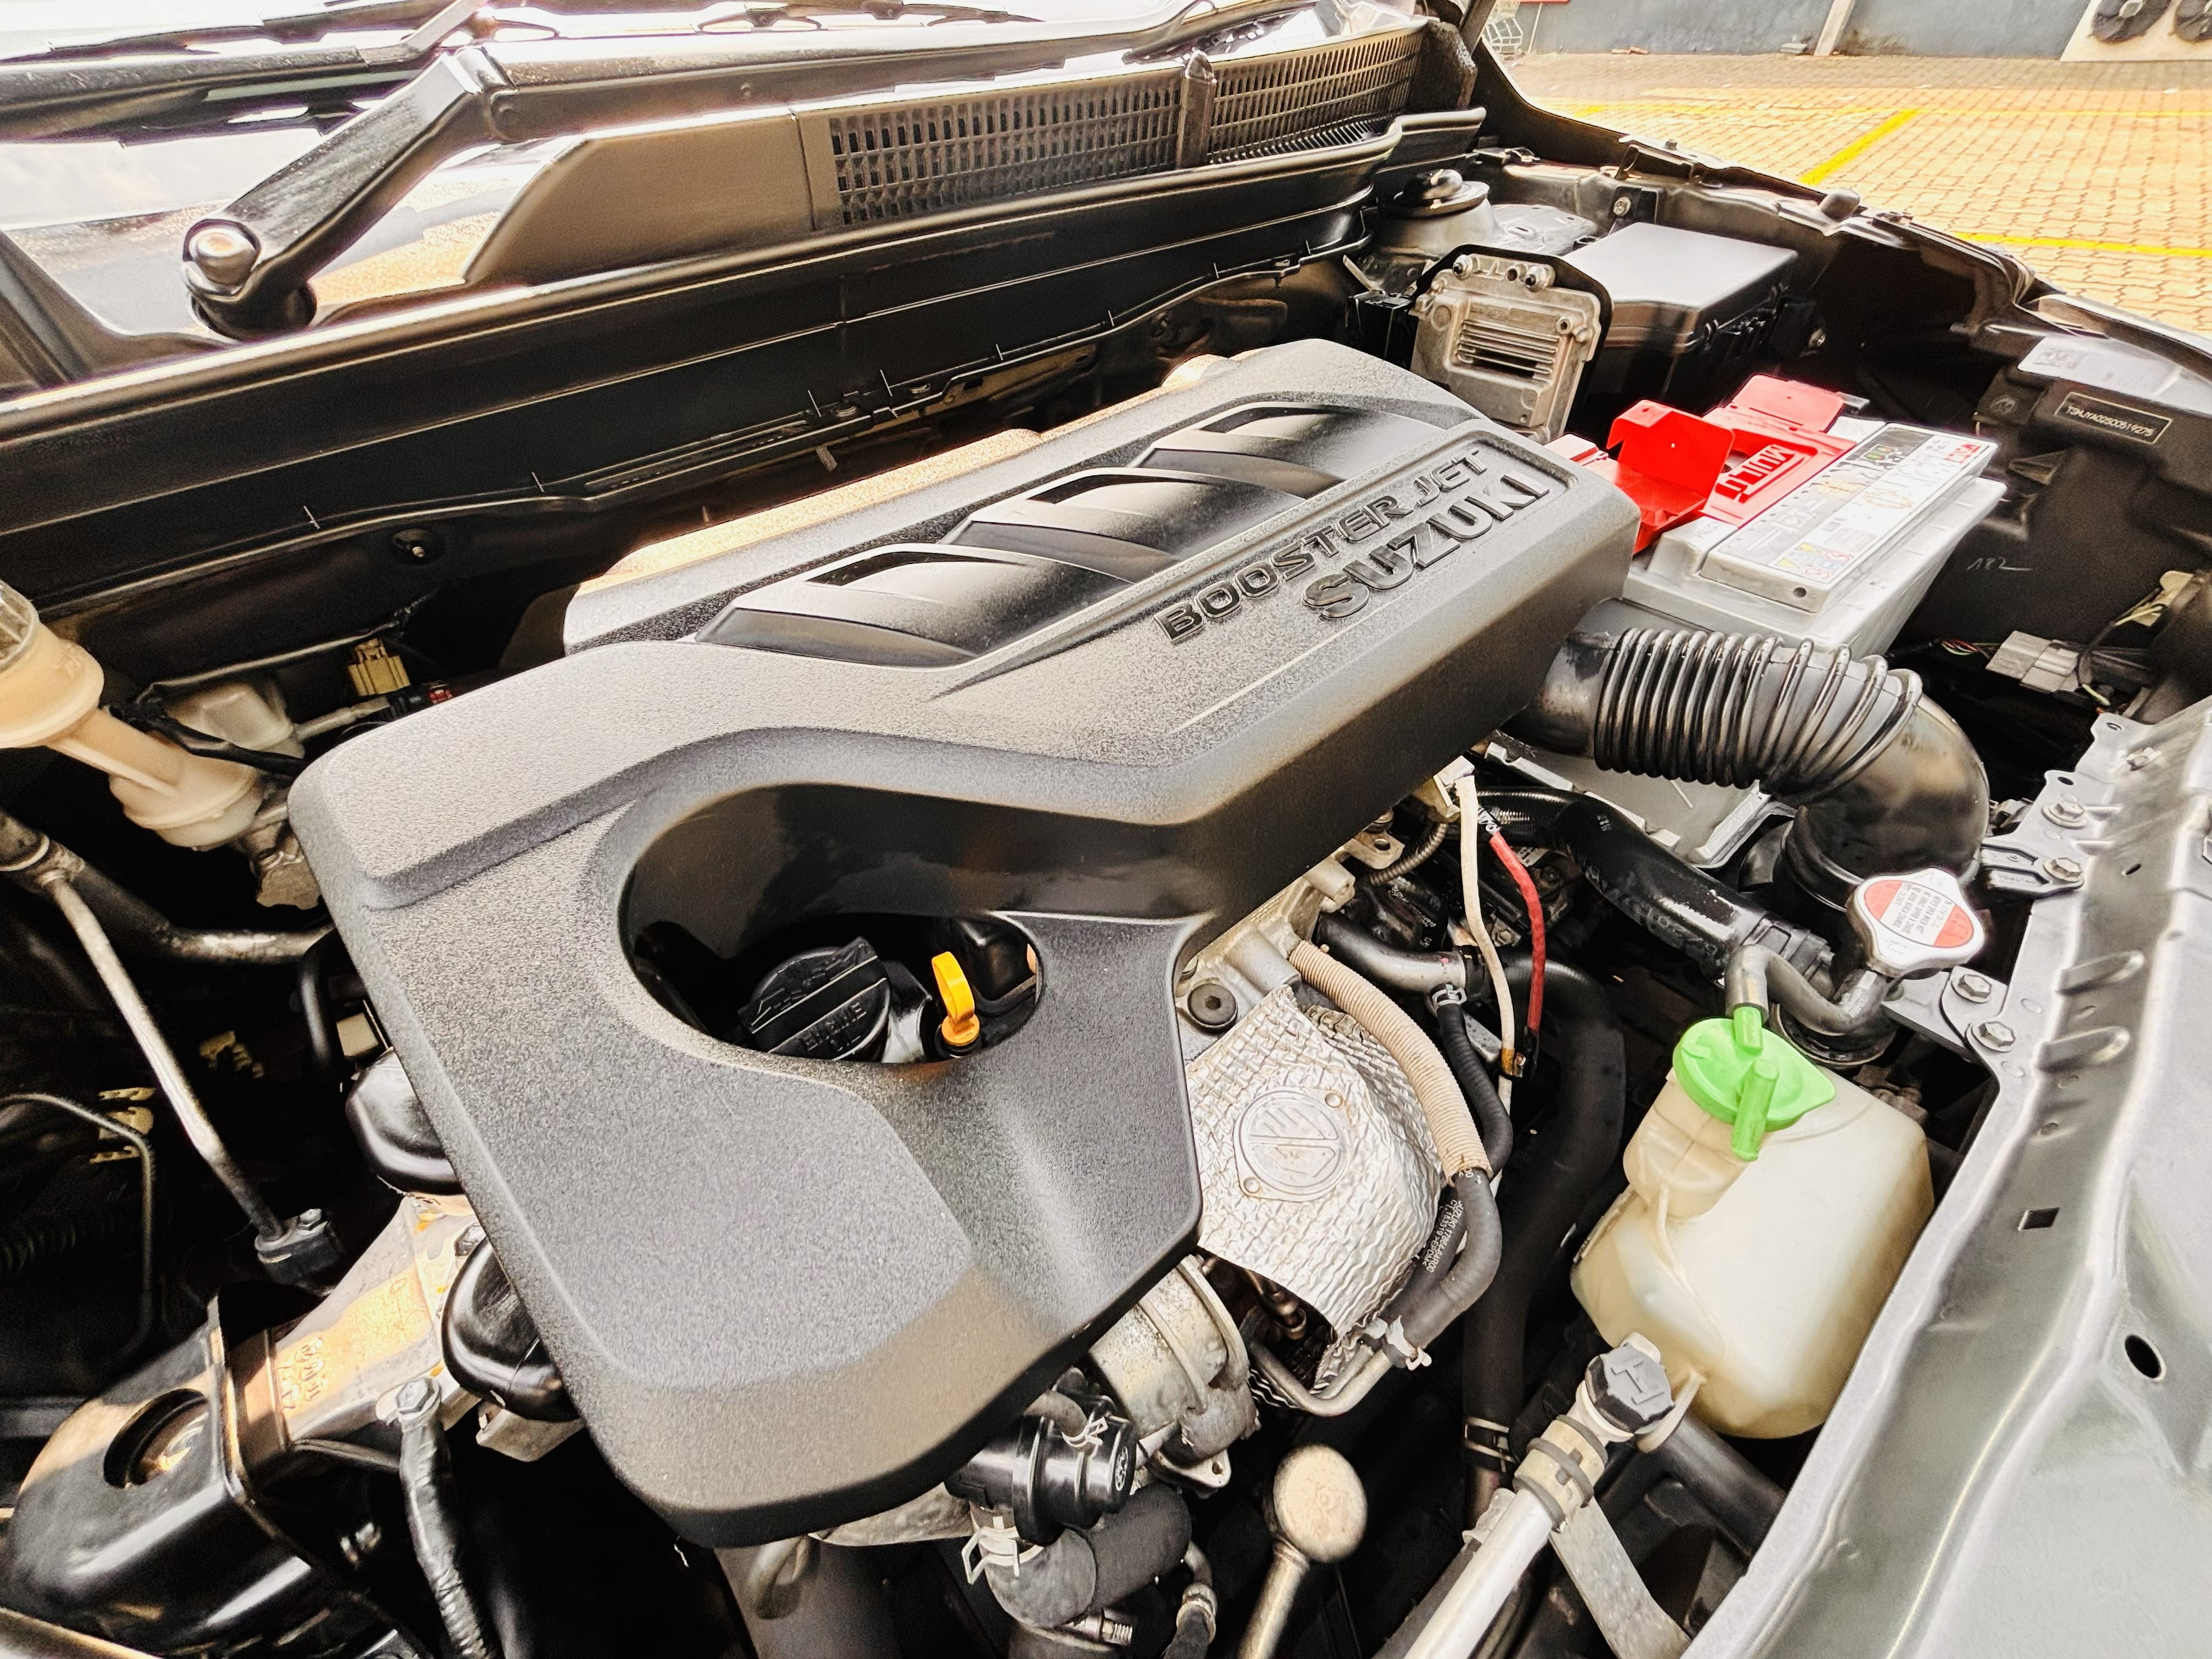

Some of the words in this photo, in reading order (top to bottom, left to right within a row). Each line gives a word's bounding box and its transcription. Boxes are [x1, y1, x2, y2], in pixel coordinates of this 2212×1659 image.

[1154, 494, 1413, 644] BOOSTER
[1415, 449, 1488, 507] JET
[1302, 469, 1550, 620] SUZUKI
